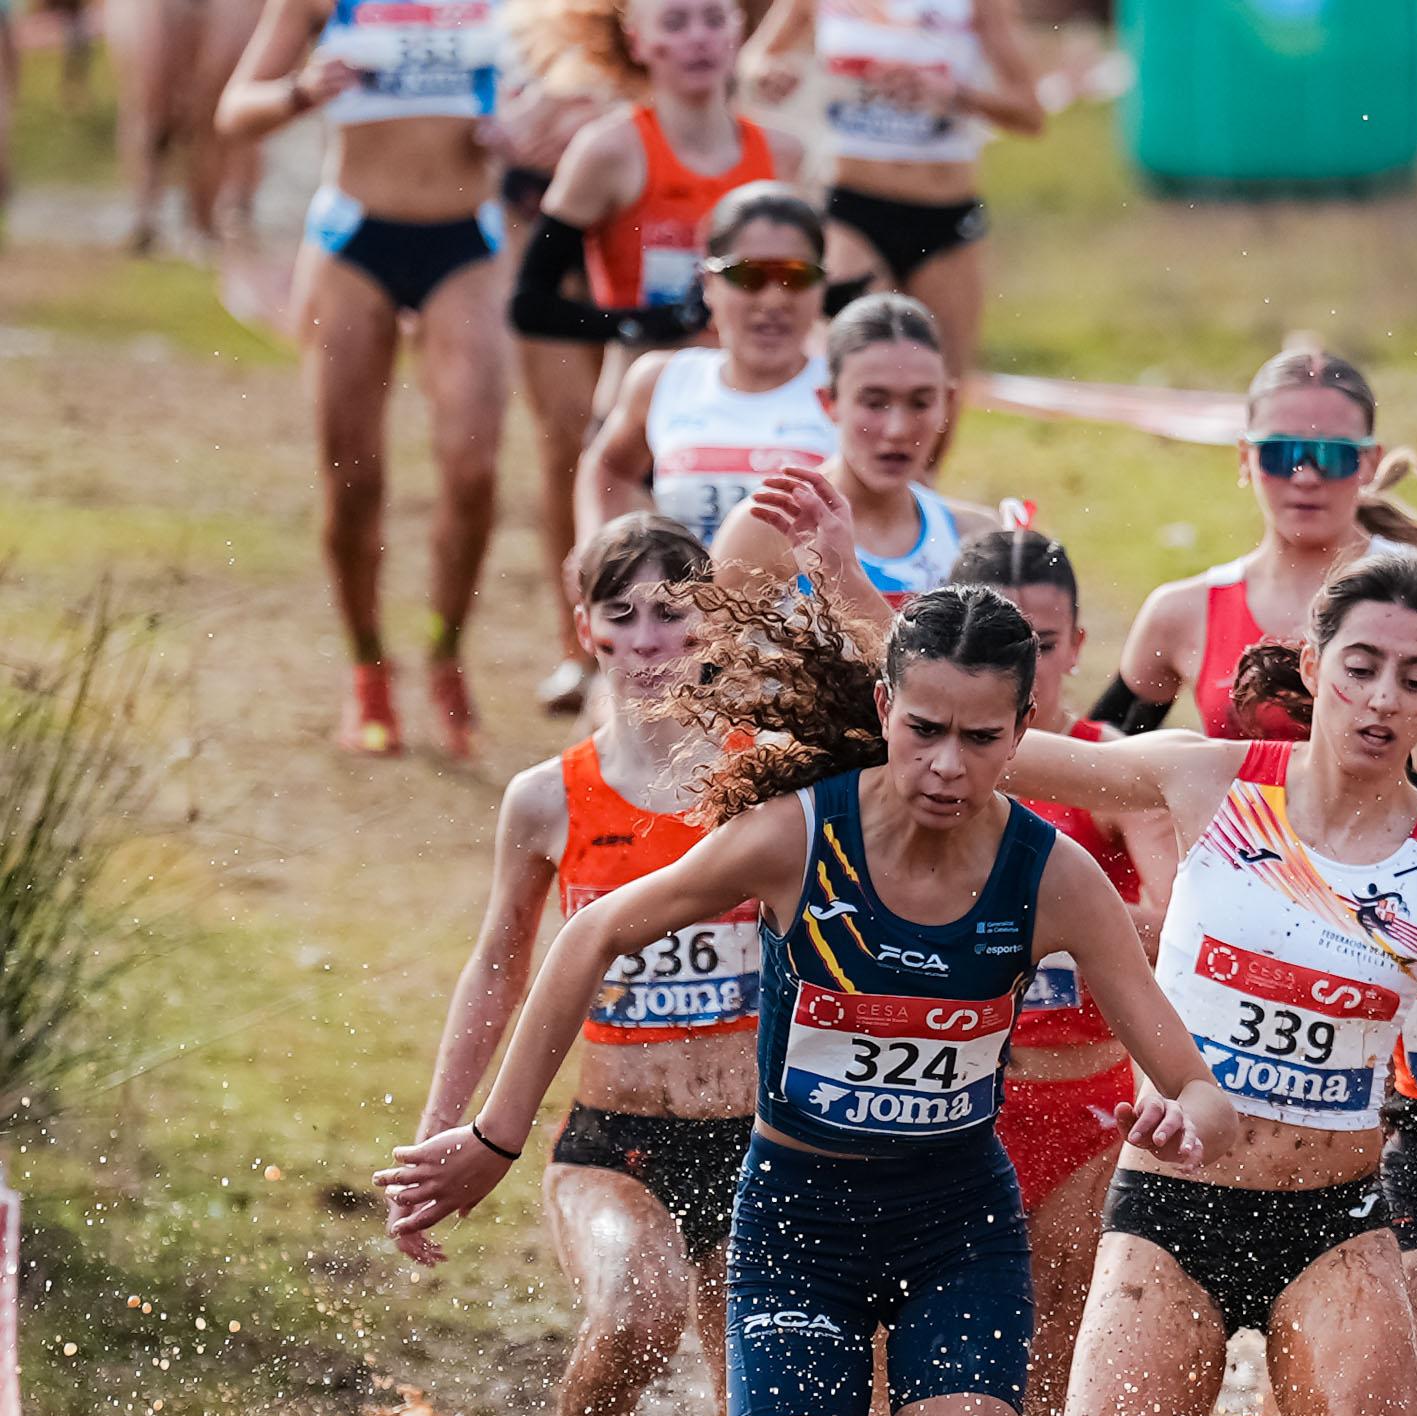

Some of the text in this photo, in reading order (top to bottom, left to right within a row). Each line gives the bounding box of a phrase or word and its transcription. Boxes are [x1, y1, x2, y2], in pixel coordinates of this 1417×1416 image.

[877, 943, 950, 972] FCA
[1248, 961, 1296, 984] CESA
[625, 979, 745, 1020] Joma
[856, 1003, 909, 1018] CESA
[1229, 1000, 1336, 1065] 339
[844, 1038, 959, 1089] 324
[1224, 1055, 1351, 1103] Joma
[845, 1091, 973, 1124] Joma
